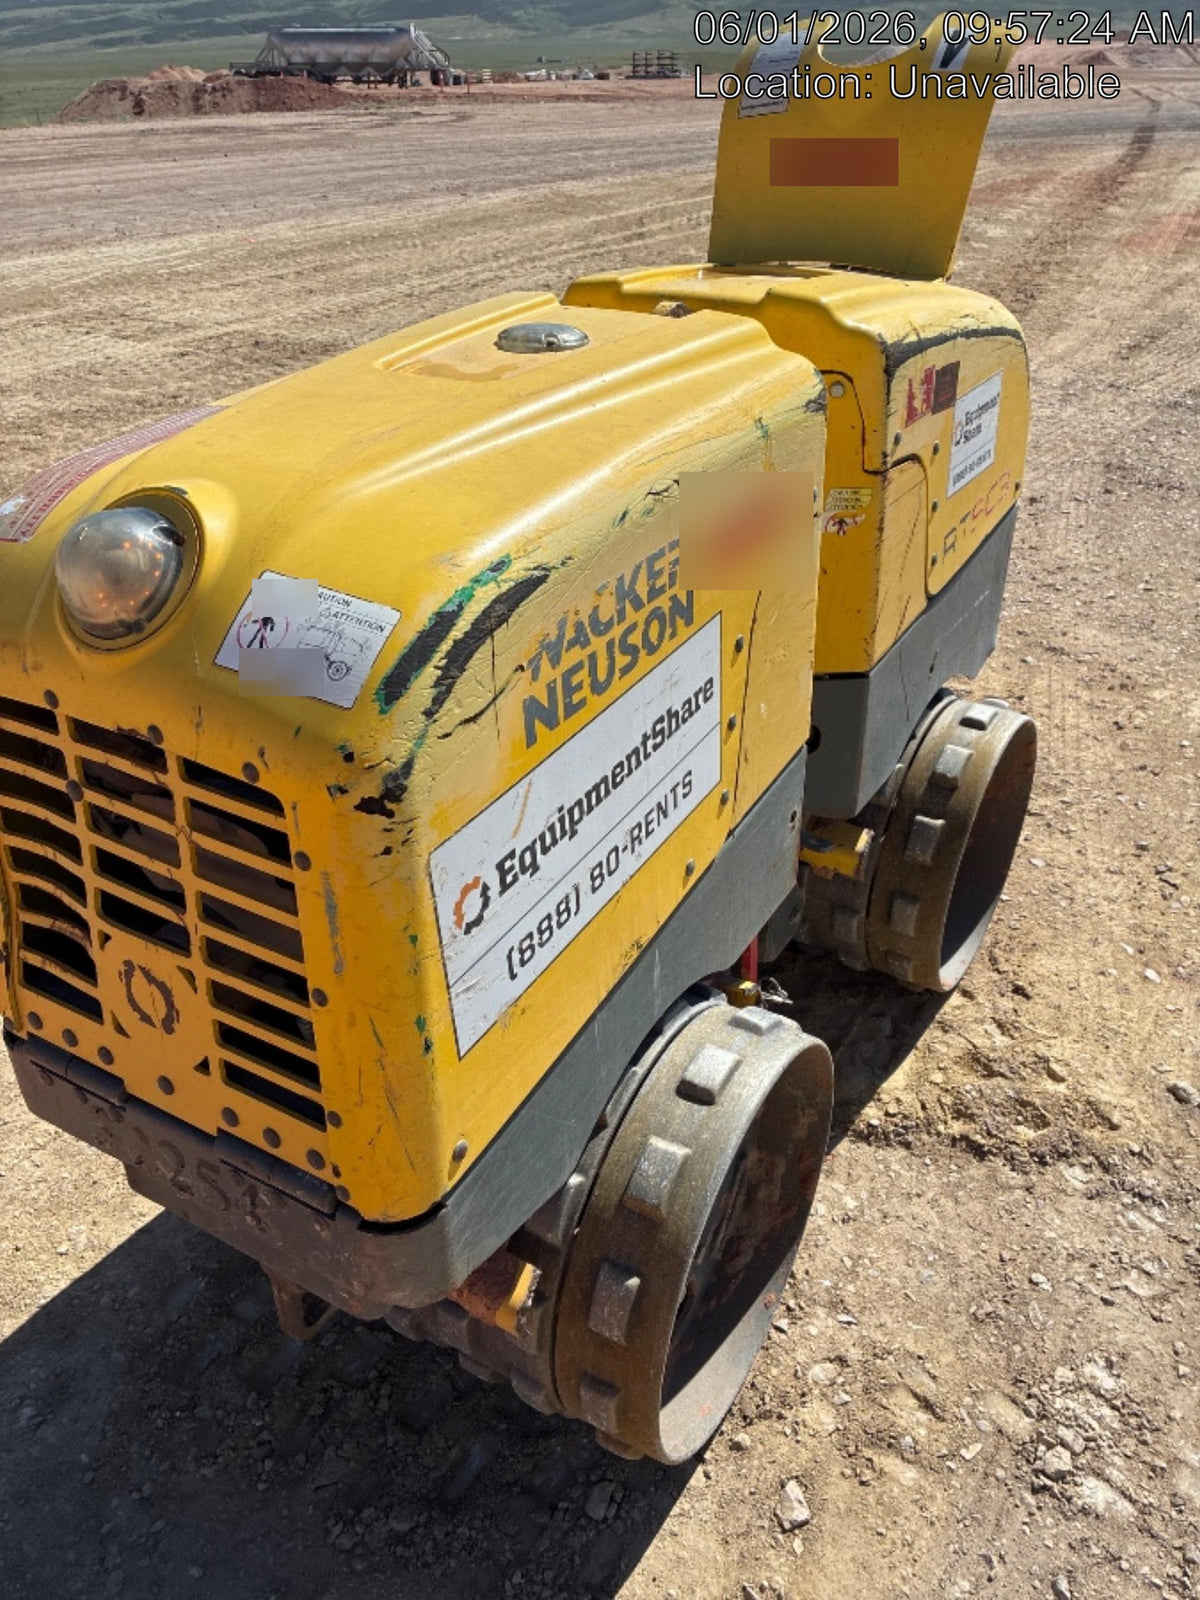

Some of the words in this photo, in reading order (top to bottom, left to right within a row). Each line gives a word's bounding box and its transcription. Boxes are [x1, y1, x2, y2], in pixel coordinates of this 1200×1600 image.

[318, 592, 353, 608] AUTION
[332, 611, 386, 633] ATTENTION
[522, 589, 694, 750] NEUSON
[495, 676, 715, 897] EquipmentShare
[505, 883, 581, 981] (888)
[589, 768, 694, 895] 80-RENTS
